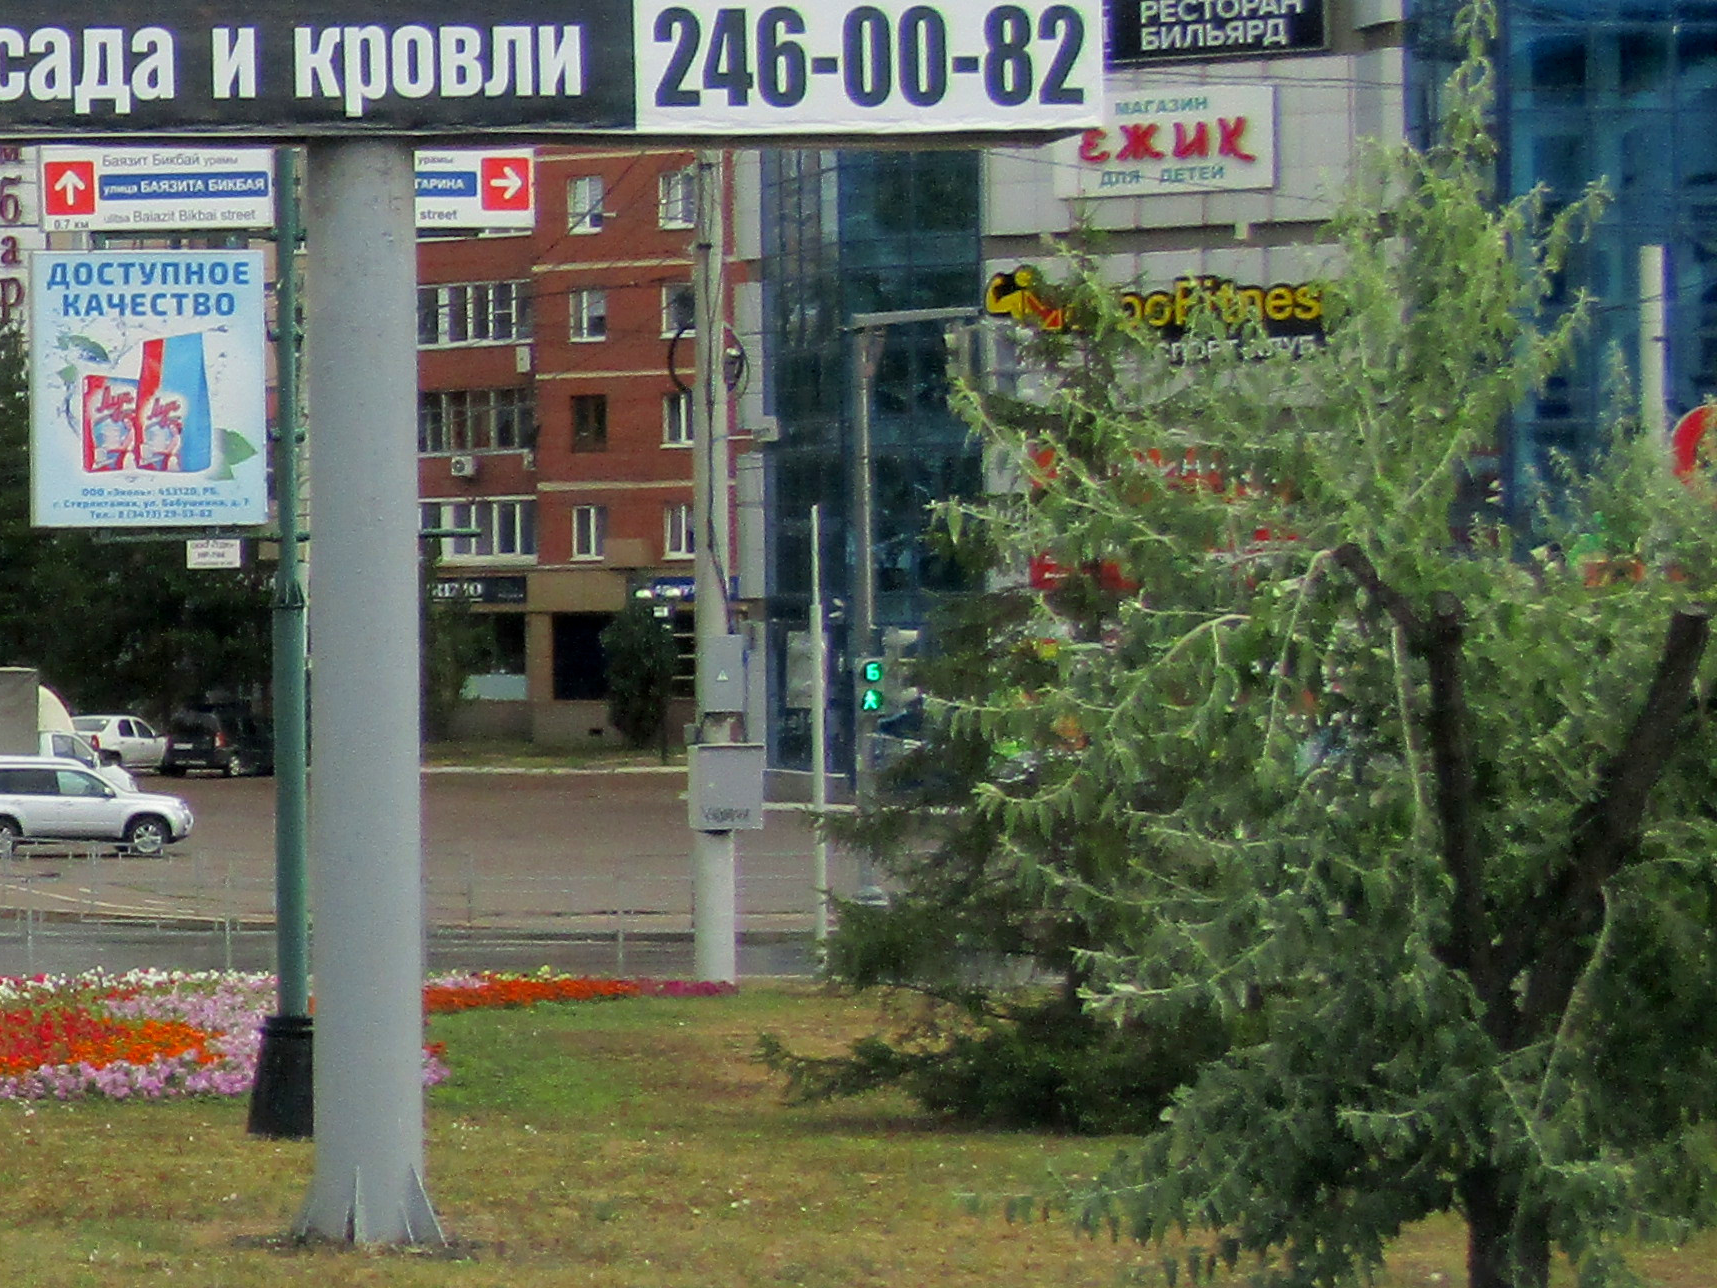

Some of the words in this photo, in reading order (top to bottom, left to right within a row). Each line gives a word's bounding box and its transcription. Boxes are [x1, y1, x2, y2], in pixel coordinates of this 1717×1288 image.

[1140, 18, 1288, 52] БИЛЬЯРД
[652, 4, 1085, 108] 246-00-82
[211, 26, 257, 100] и
[293, 23, 582, 118] кровли
[1115, 97, 1208, 114] МАГАЗИН
[102, 155, 148, 168] Баязит
[152, 153, 201, 167] Бикбай
[415, 178, 465, 190] ГАРИНА
[1099, 170, 1141, 188] ДЛЯ
[1160, 165, 1224, 184] ДЕТЕЙ
[103, 184, 138, 196] улица
[140, 179, 206, 194] БАЯЗИТА
[208, 178, 266, 192] БИКБАЯ
[220, 208, 256, 221] street
[419, 209, 458, 220] street
[46, 261, 251, 290] ДОСТУПНОЕ
[62, 292, 236, 317] КАЧЕСТВО
[82, 488, 105, 497] ООО
